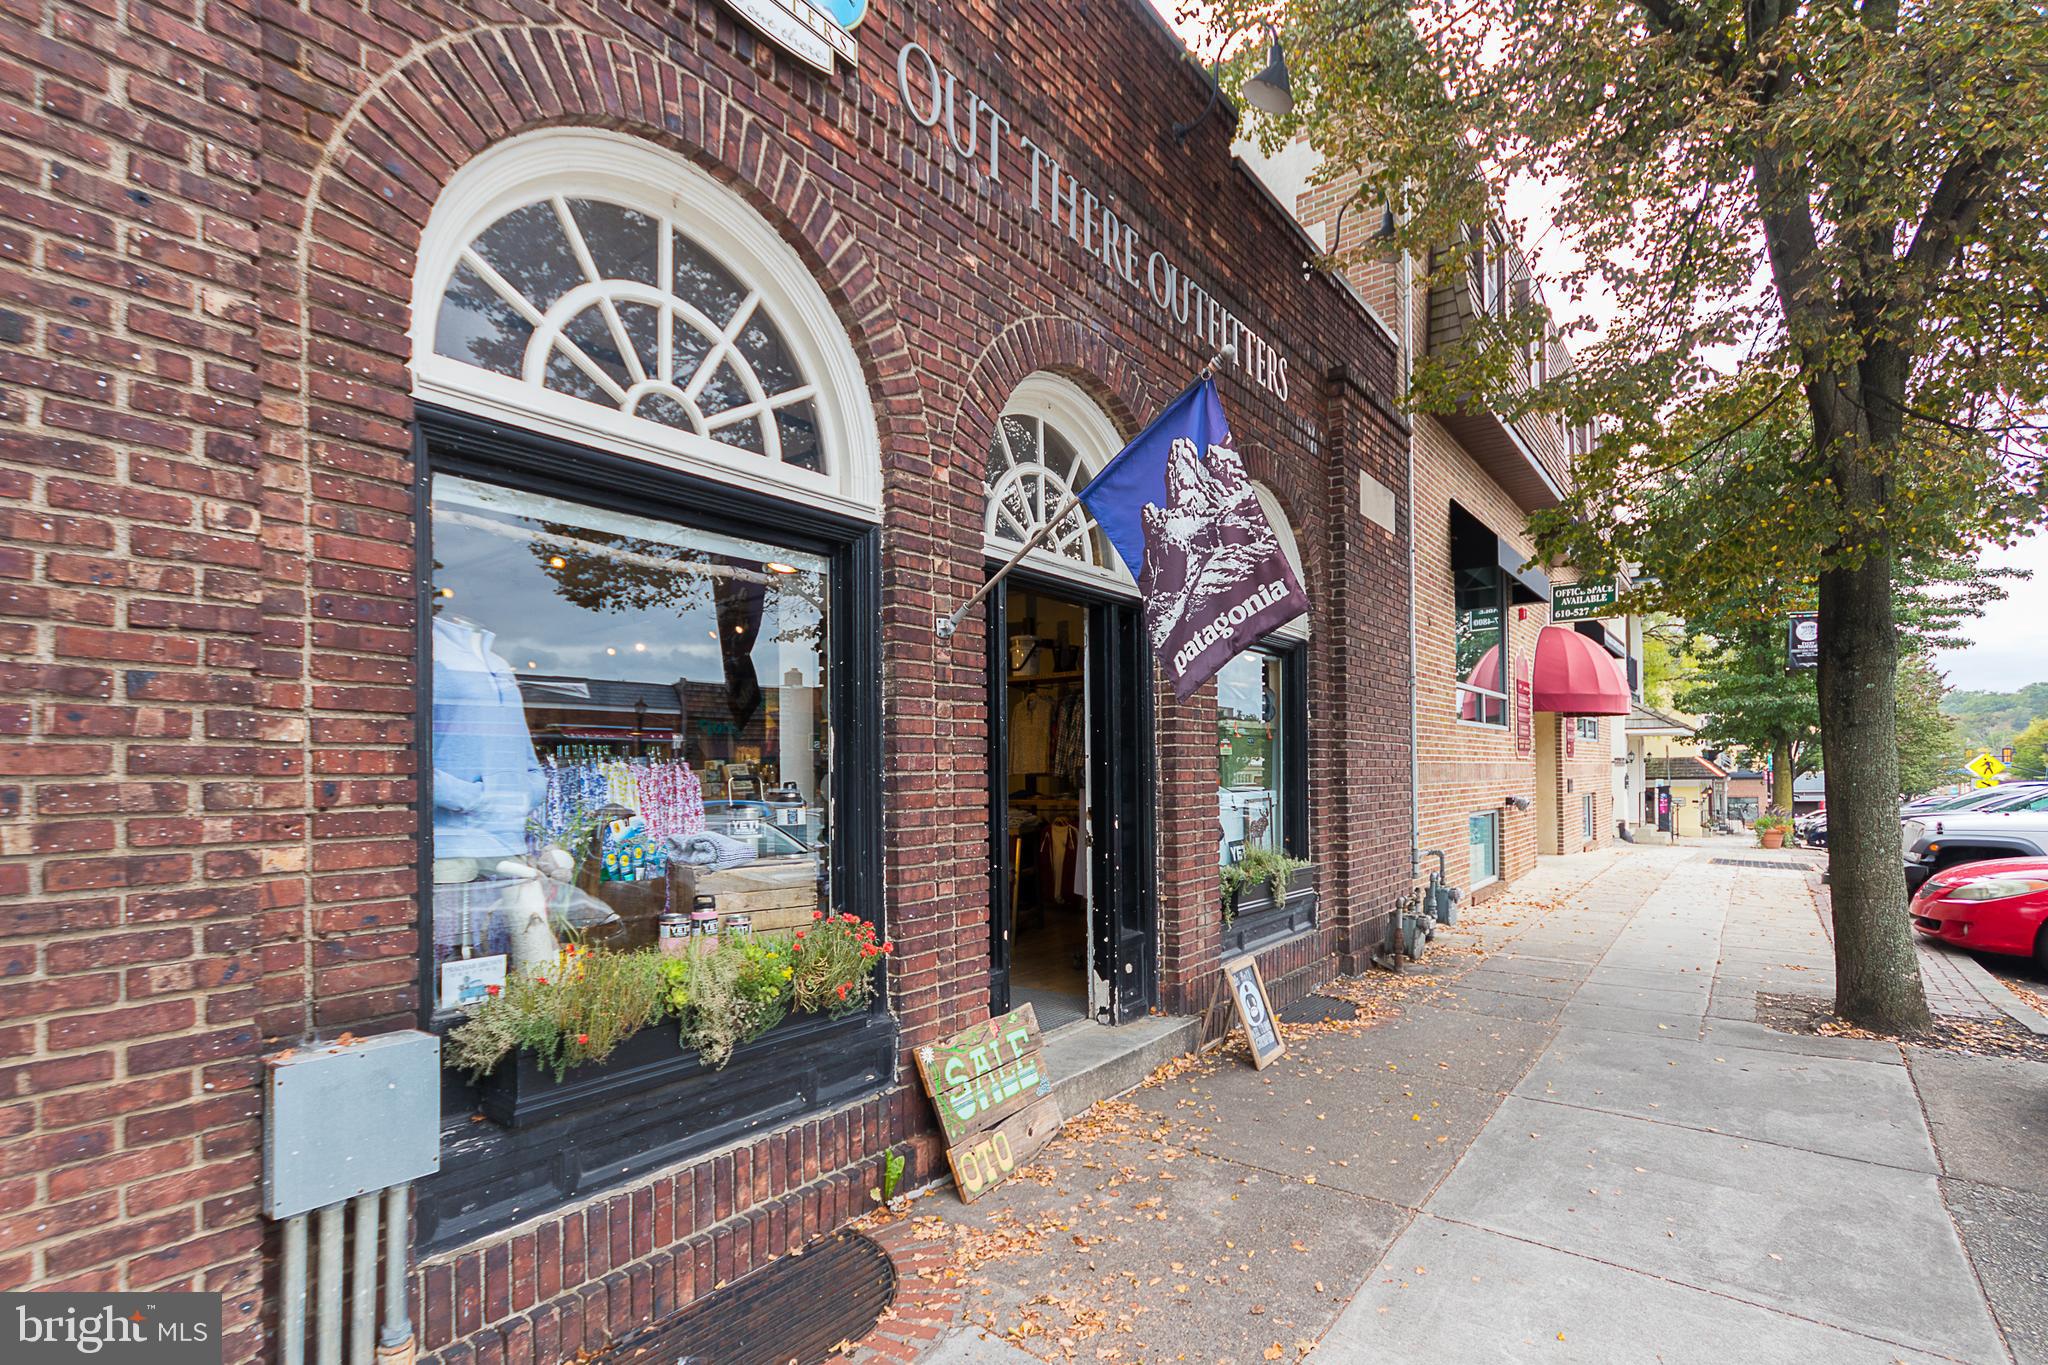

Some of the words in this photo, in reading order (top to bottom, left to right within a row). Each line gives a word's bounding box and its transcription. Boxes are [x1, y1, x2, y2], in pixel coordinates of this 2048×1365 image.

[897, 42, 1011, 184] OUT
[1020, 136, 1141, 289] THERE
[1148, 251, 1289, 402] OUTFITTERS
[1173, 578, 1291, 678] patagonia
[1561, 593, 1608, 606] AVAILABLE
[944, 1027, 1041, 1121] SALE
[959, 1130, 1015, 1193] OTO
